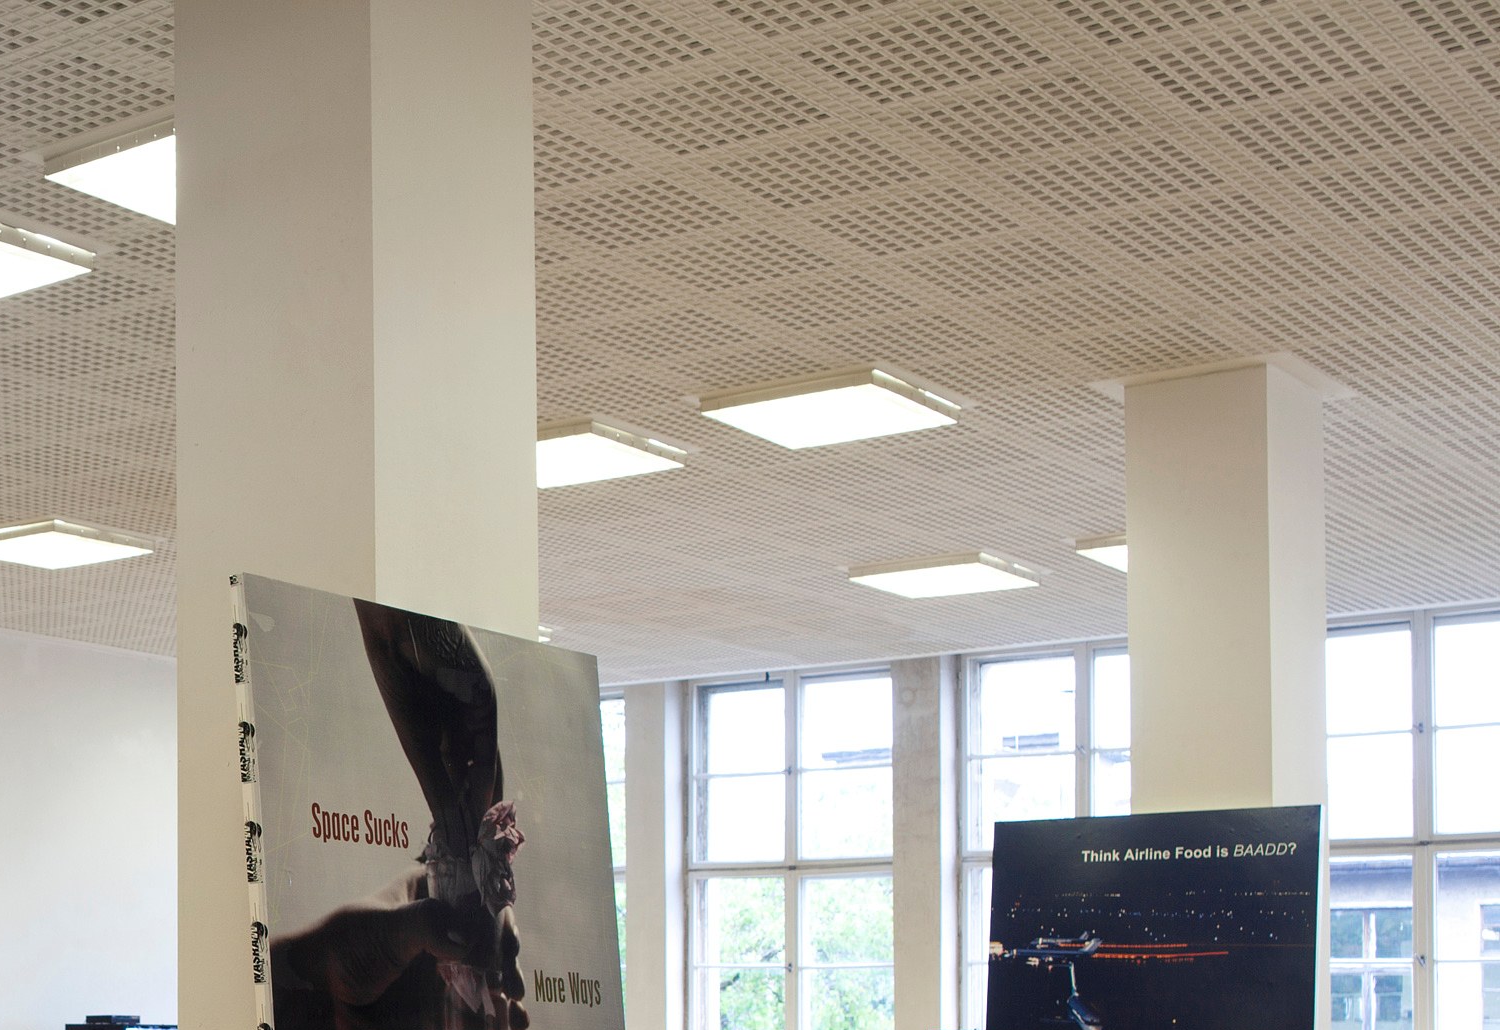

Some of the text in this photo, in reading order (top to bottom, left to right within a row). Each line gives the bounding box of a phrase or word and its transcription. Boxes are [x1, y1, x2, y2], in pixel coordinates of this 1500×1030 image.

[311, 802, 409, 849] Space Sucks
[1081, 842, 1297, 863] Think Airline Food is BAADD?
[534, 969, 601, 1008] More Ways
